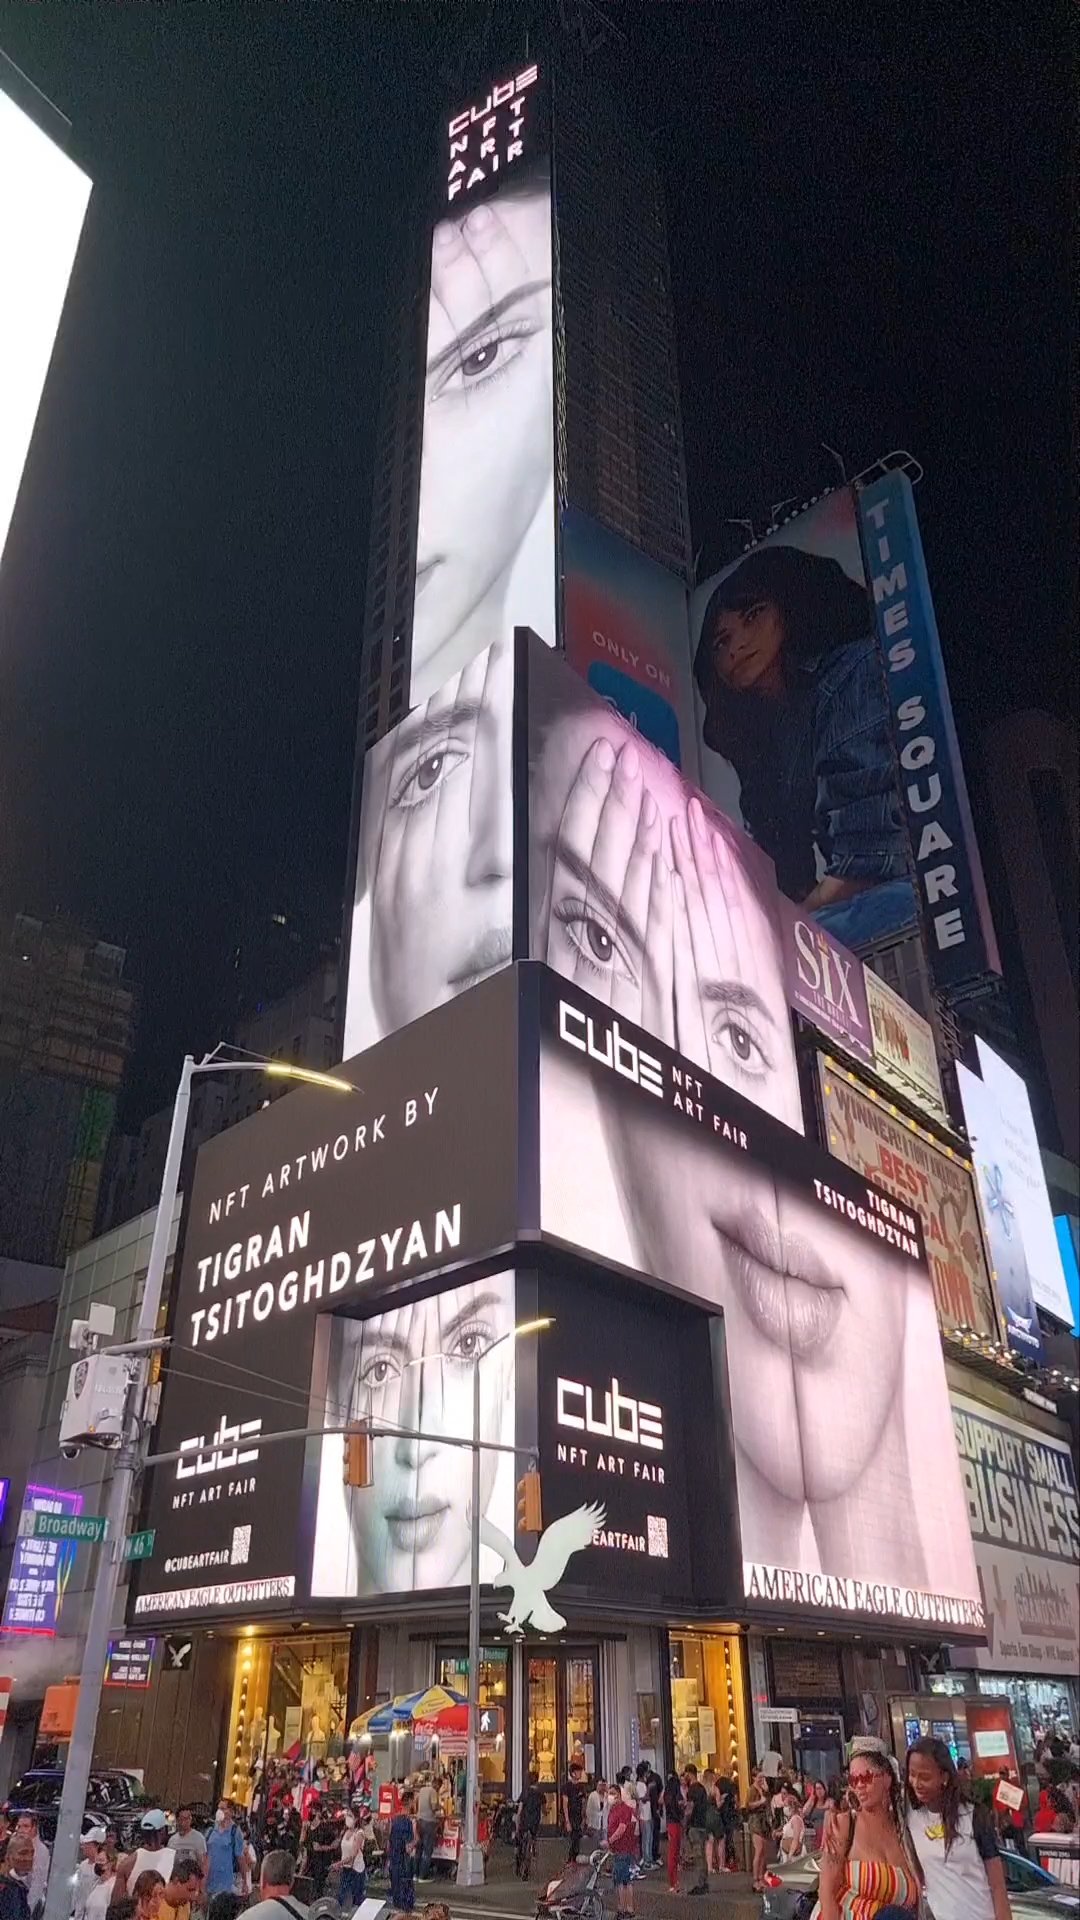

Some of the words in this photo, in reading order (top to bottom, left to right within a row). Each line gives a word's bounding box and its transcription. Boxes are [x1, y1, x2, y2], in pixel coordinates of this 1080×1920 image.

[448, 117, 525, 181] ART
[450, 96, 526, 161] NFT
[448, 140, 523, 201] FAIR
[592, 631, 639, 668] ONLY
[646, 663, 671, 688] ON
[866, 499, 916, 673] TIMES
[897, 695, 967, 951] SQUARE
[672, 1065, 703, 1098] NFT
[673, 1091, 704, 1122] ART
[713, 1114, 748, 1150] FAIR
[208, 1184, 250, 1224] NFT
[261, 1114, 386, 1198] ARTWORK
[404, 1087, 439, 1127] BY
[878, 1143, 929, 1204] BEST
[813, 1178, 920, 1260] TSITOGHDZYAN
[866, 1189, 916, 1235] TIGRAN
[191, 1203, 462, 1347] TSITOGHDZYAN
[197, 1210, 311, 1293] TIGRAN
[172, 1490, 195, 1510] NFT
[199, 1484, 222, 1504] ART
[228, 1477, 257, 1497] FAIR
[557, 1444, 588, 1468] NFT
[597, 1453, 625, 1476] ART
[633, 1461, 666, 1485] FAIR
[38, 1515, 103, 1540] Broadway
[134, 1535, 146, 1556] 46
[592, 1528, 646, 1553] EARTFAIR
[749, 1563, 849, 1611] AMERICAN
[850, 1579, 902, 1617] EAGLE
[904, 1590, 985, 1626] OUTFITTERS
